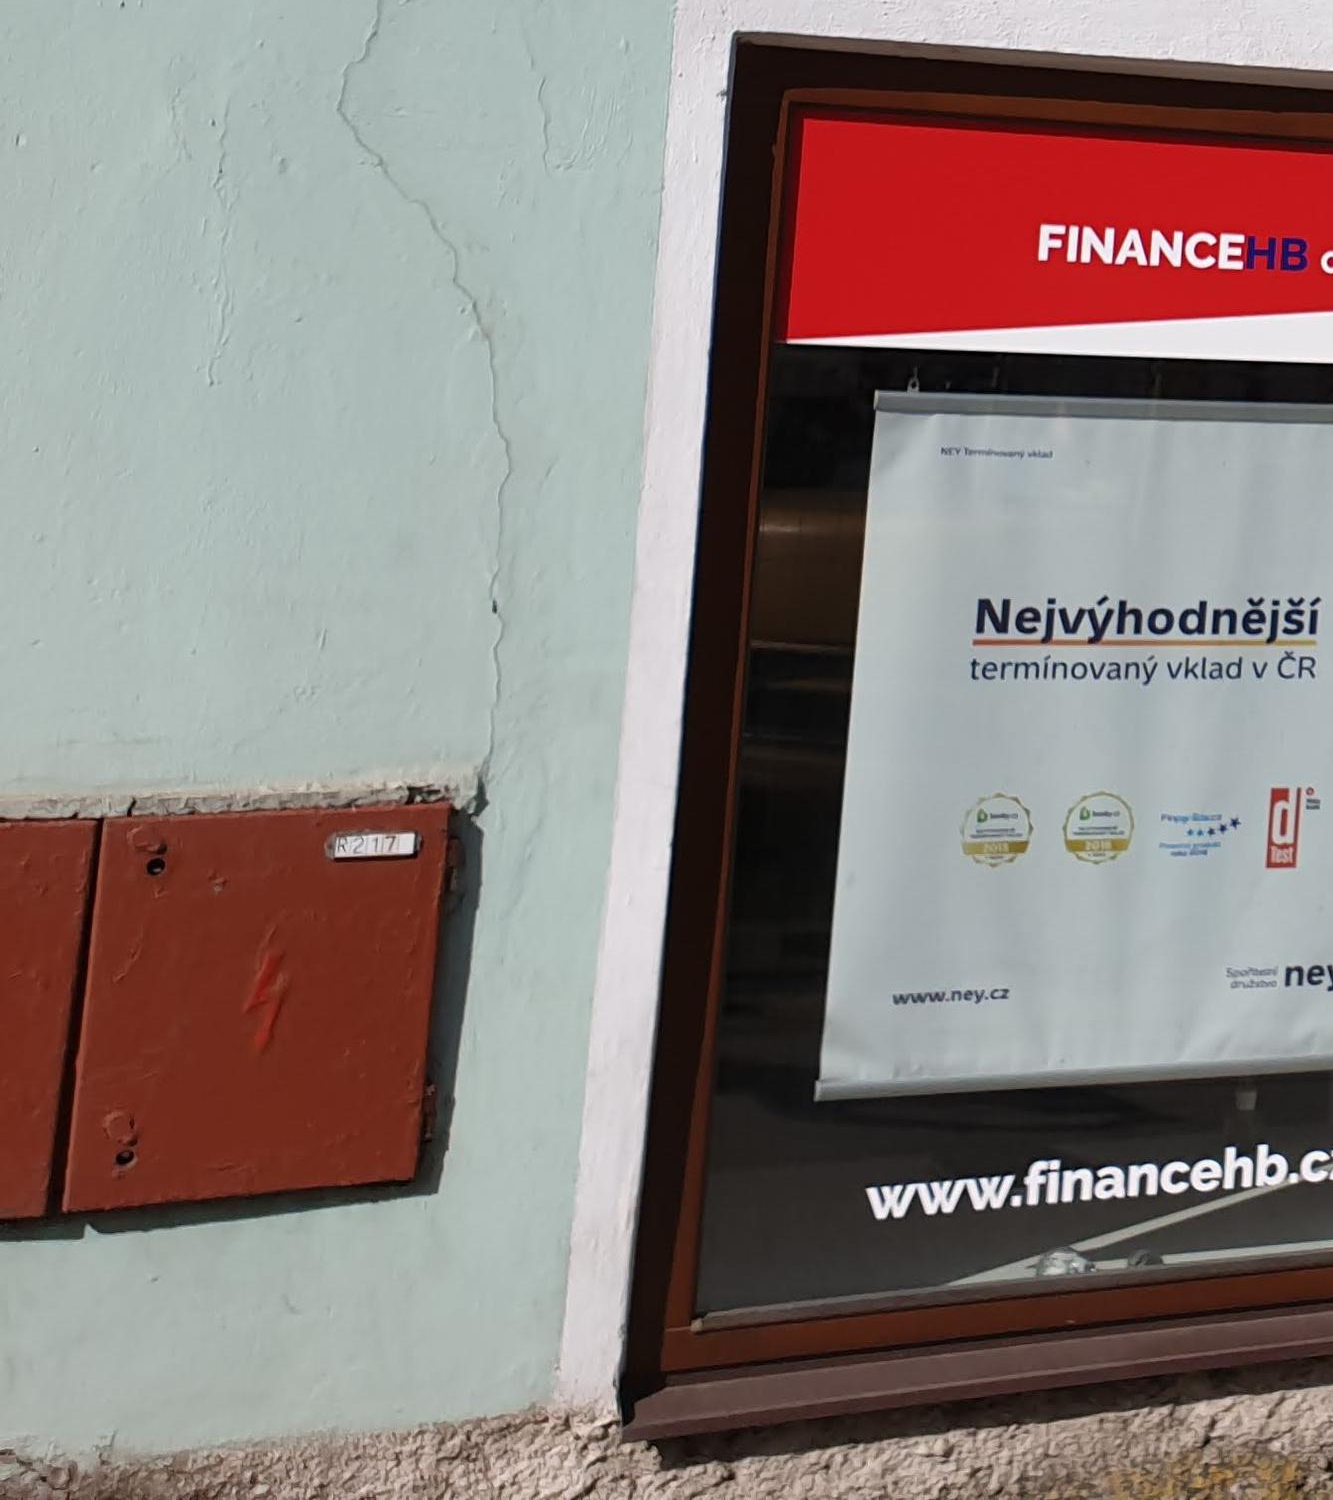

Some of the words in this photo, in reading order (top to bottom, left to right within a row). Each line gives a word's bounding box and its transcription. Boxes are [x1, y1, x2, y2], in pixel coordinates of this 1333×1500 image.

[1038, 223, 1309, 272] FINANCEHB
[975, 595, 1322, 645] Nejvýhodnější
[970, 654, 1158, 686] termínovaný
[1166, 657, 1243, 680] vklad
[1252, 662, 1268, 680] v
[1277, 651, 1317, 680] ČR
[892, 988, 1010, 1005] www.ney.cz
